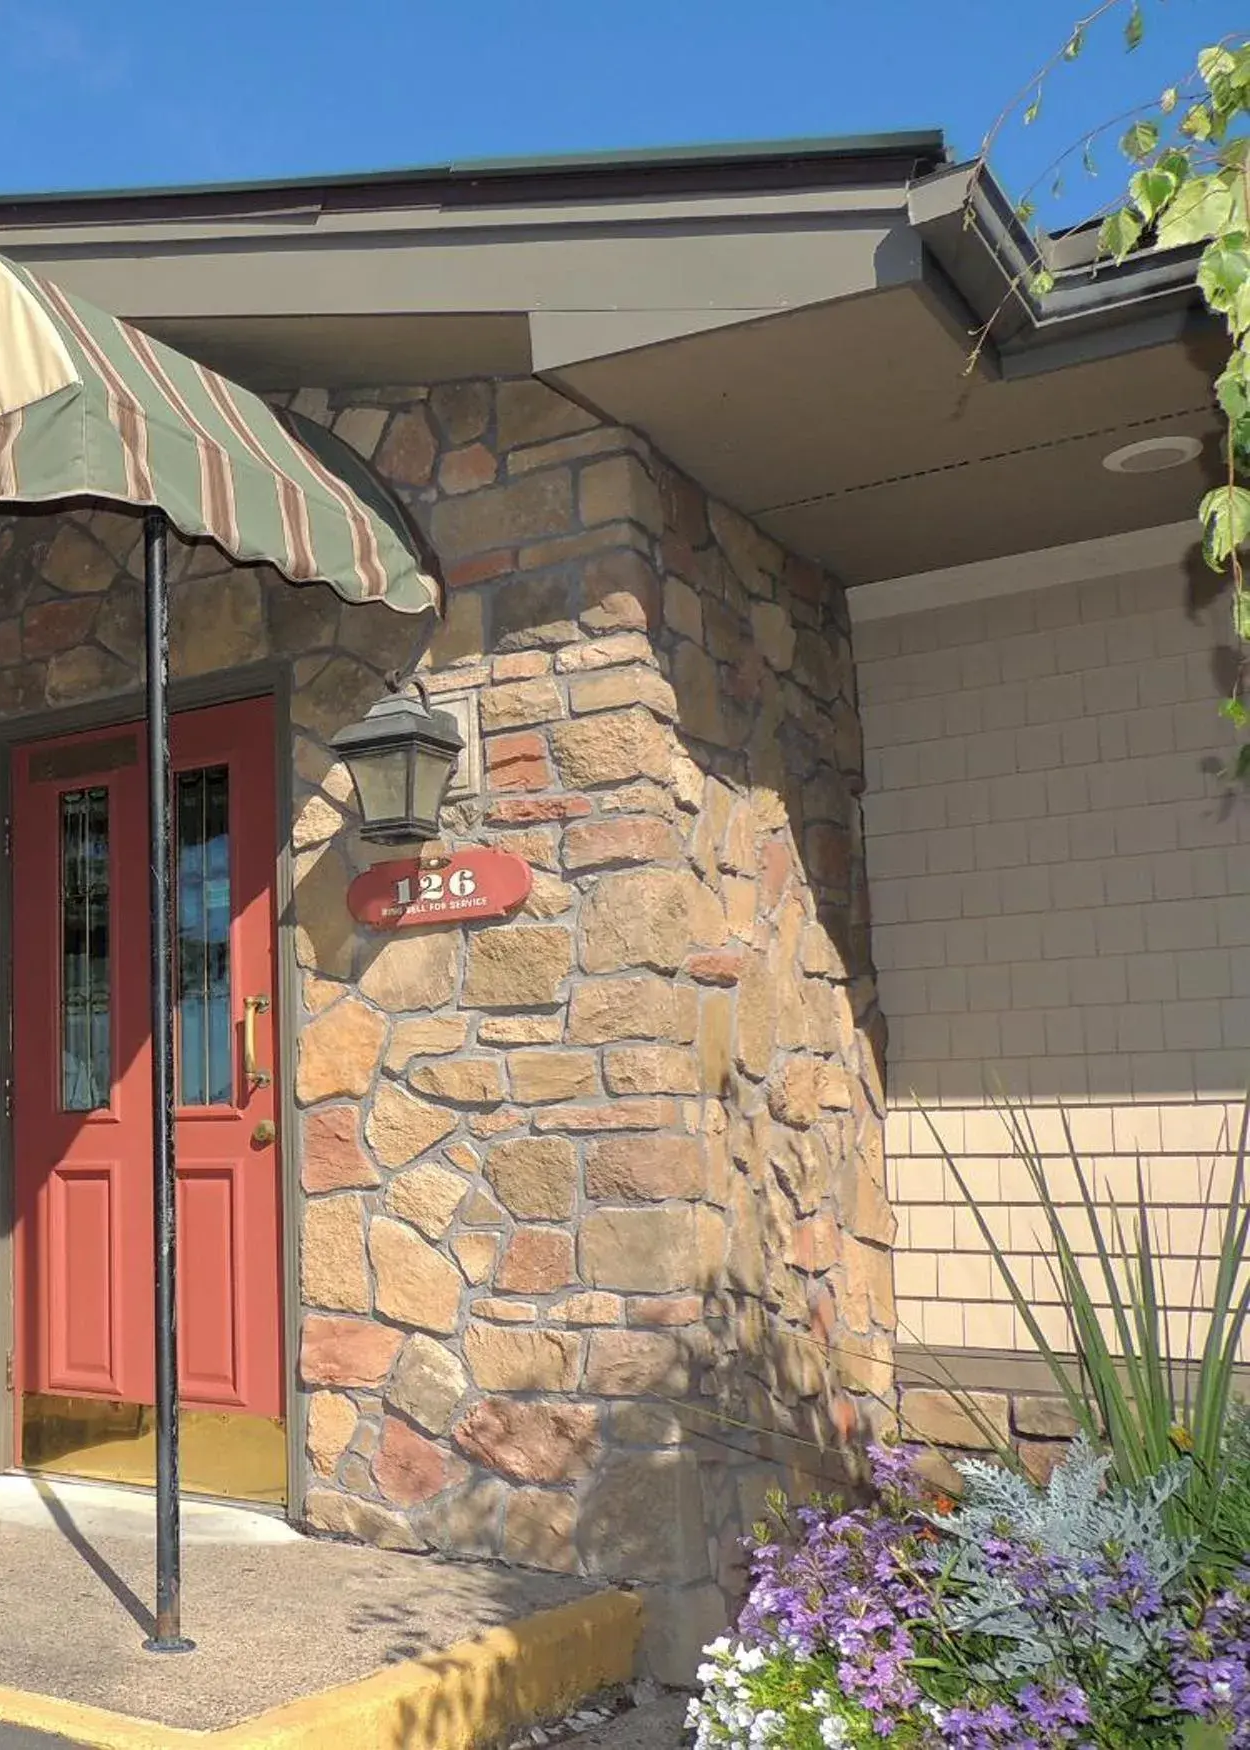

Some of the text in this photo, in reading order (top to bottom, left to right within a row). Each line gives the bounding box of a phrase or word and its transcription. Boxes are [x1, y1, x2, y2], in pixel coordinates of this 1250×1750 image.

[395, 869, 477, 904] 126
[429, 902, 447, 912] FOR
[449, 896, 488, 910] SERVICE
